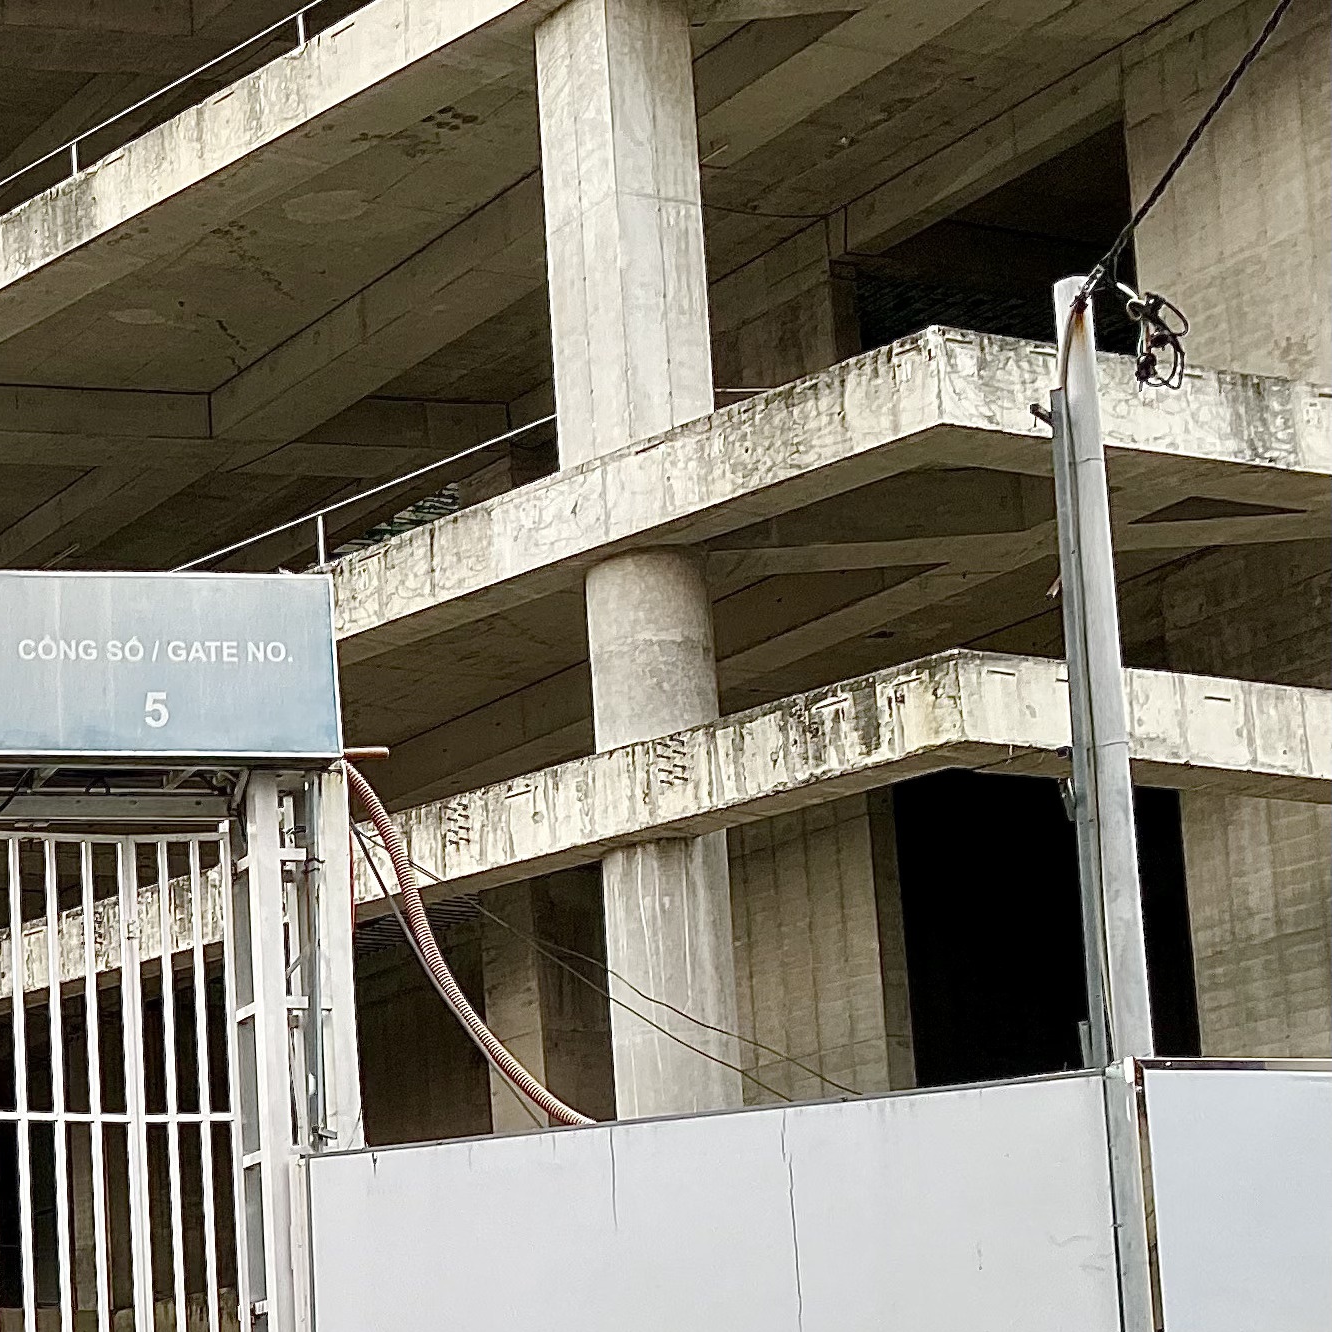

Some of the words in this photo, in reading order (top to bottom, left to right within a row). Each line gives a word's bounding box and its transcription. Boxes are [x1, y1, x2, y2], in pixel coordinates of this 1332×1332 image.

[151, 639, 160, 663] /
[167, 640, 240, 664] GATE
[246, 641, 295, 664] NO.
[144, 691, 170, 729] 5
